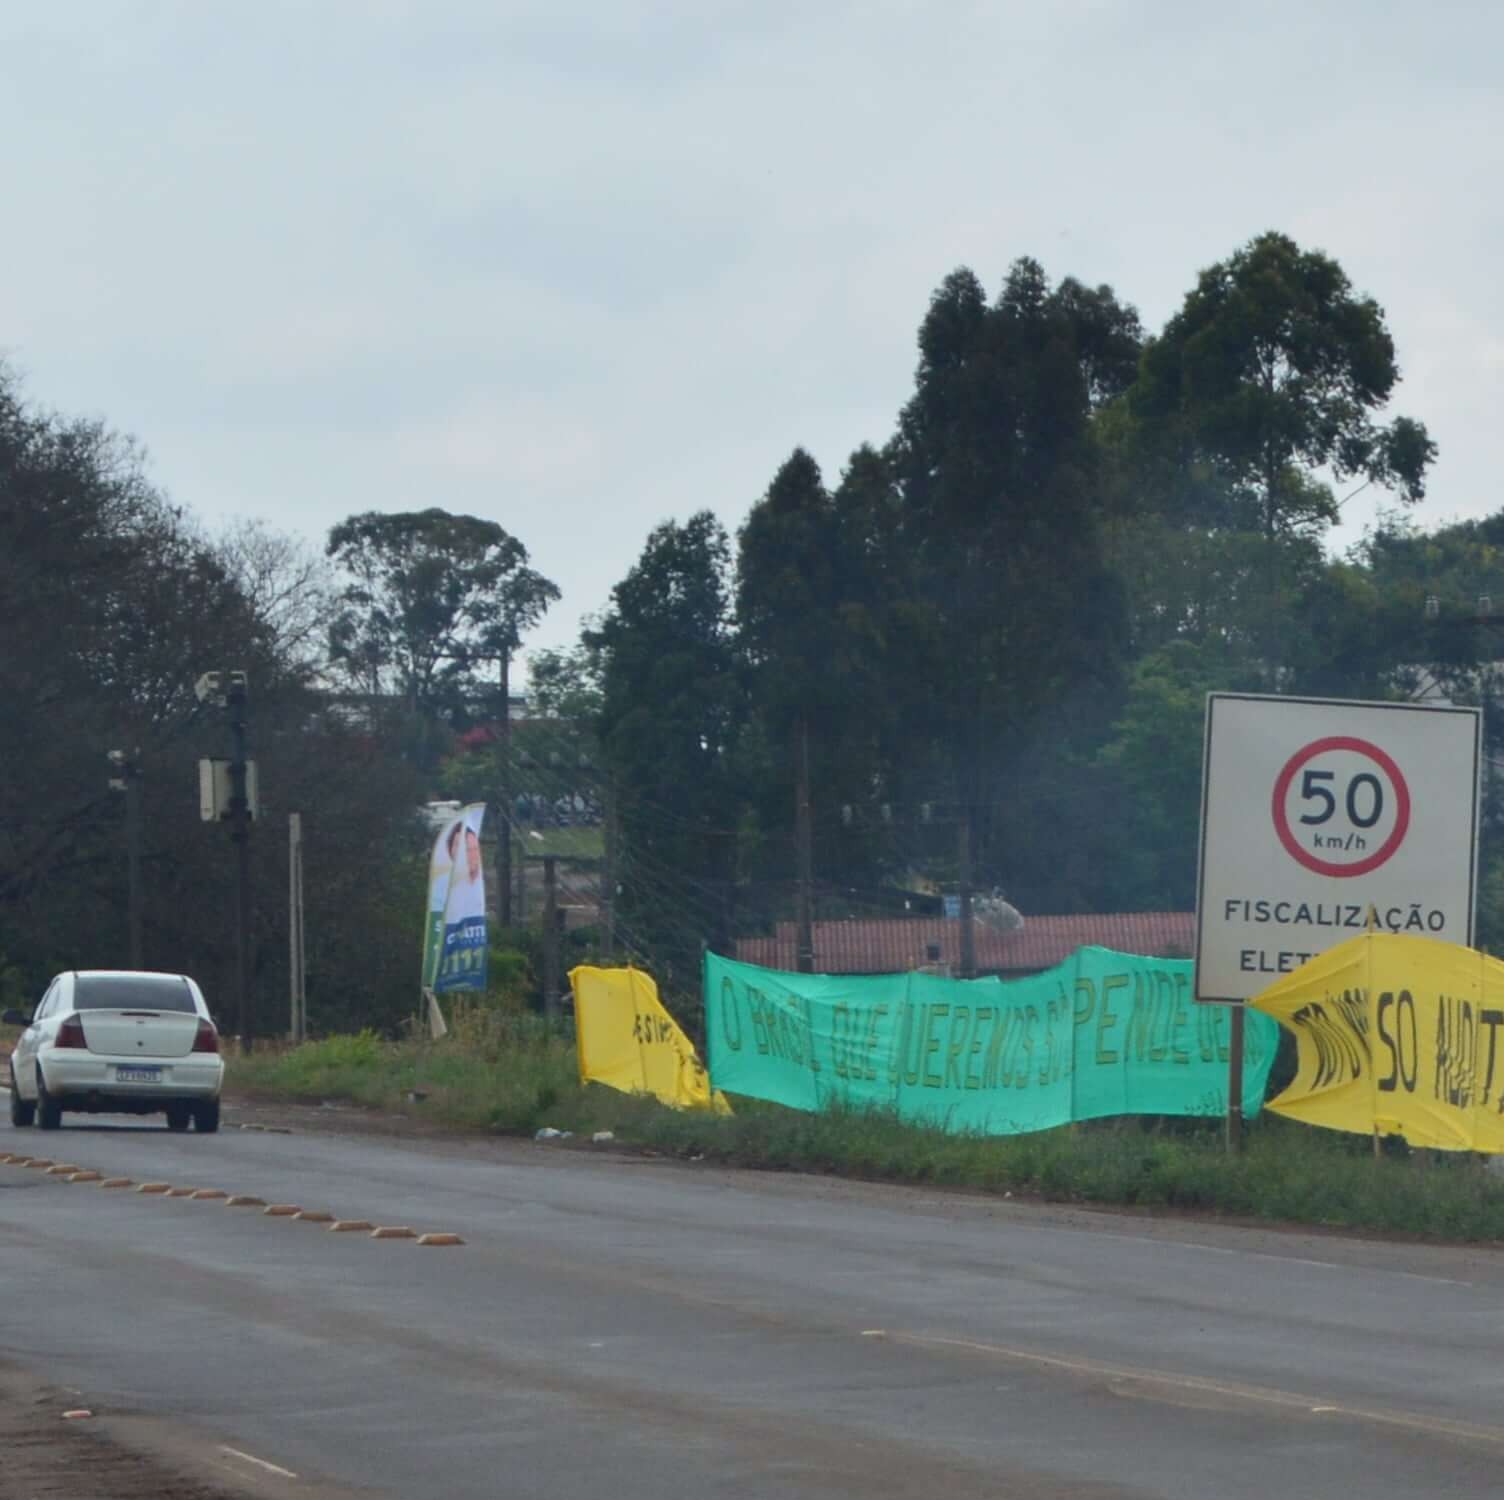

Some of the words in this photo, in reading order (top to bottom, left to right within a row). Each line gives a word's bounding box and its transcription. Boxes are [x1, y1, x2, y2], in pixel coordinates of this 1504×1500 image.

[1299, 769, 1384, 829] 50
[1313, 832, 1366, 852] km/h
[1224, 899, 1447, 934] FISCALIZAÇÃO
